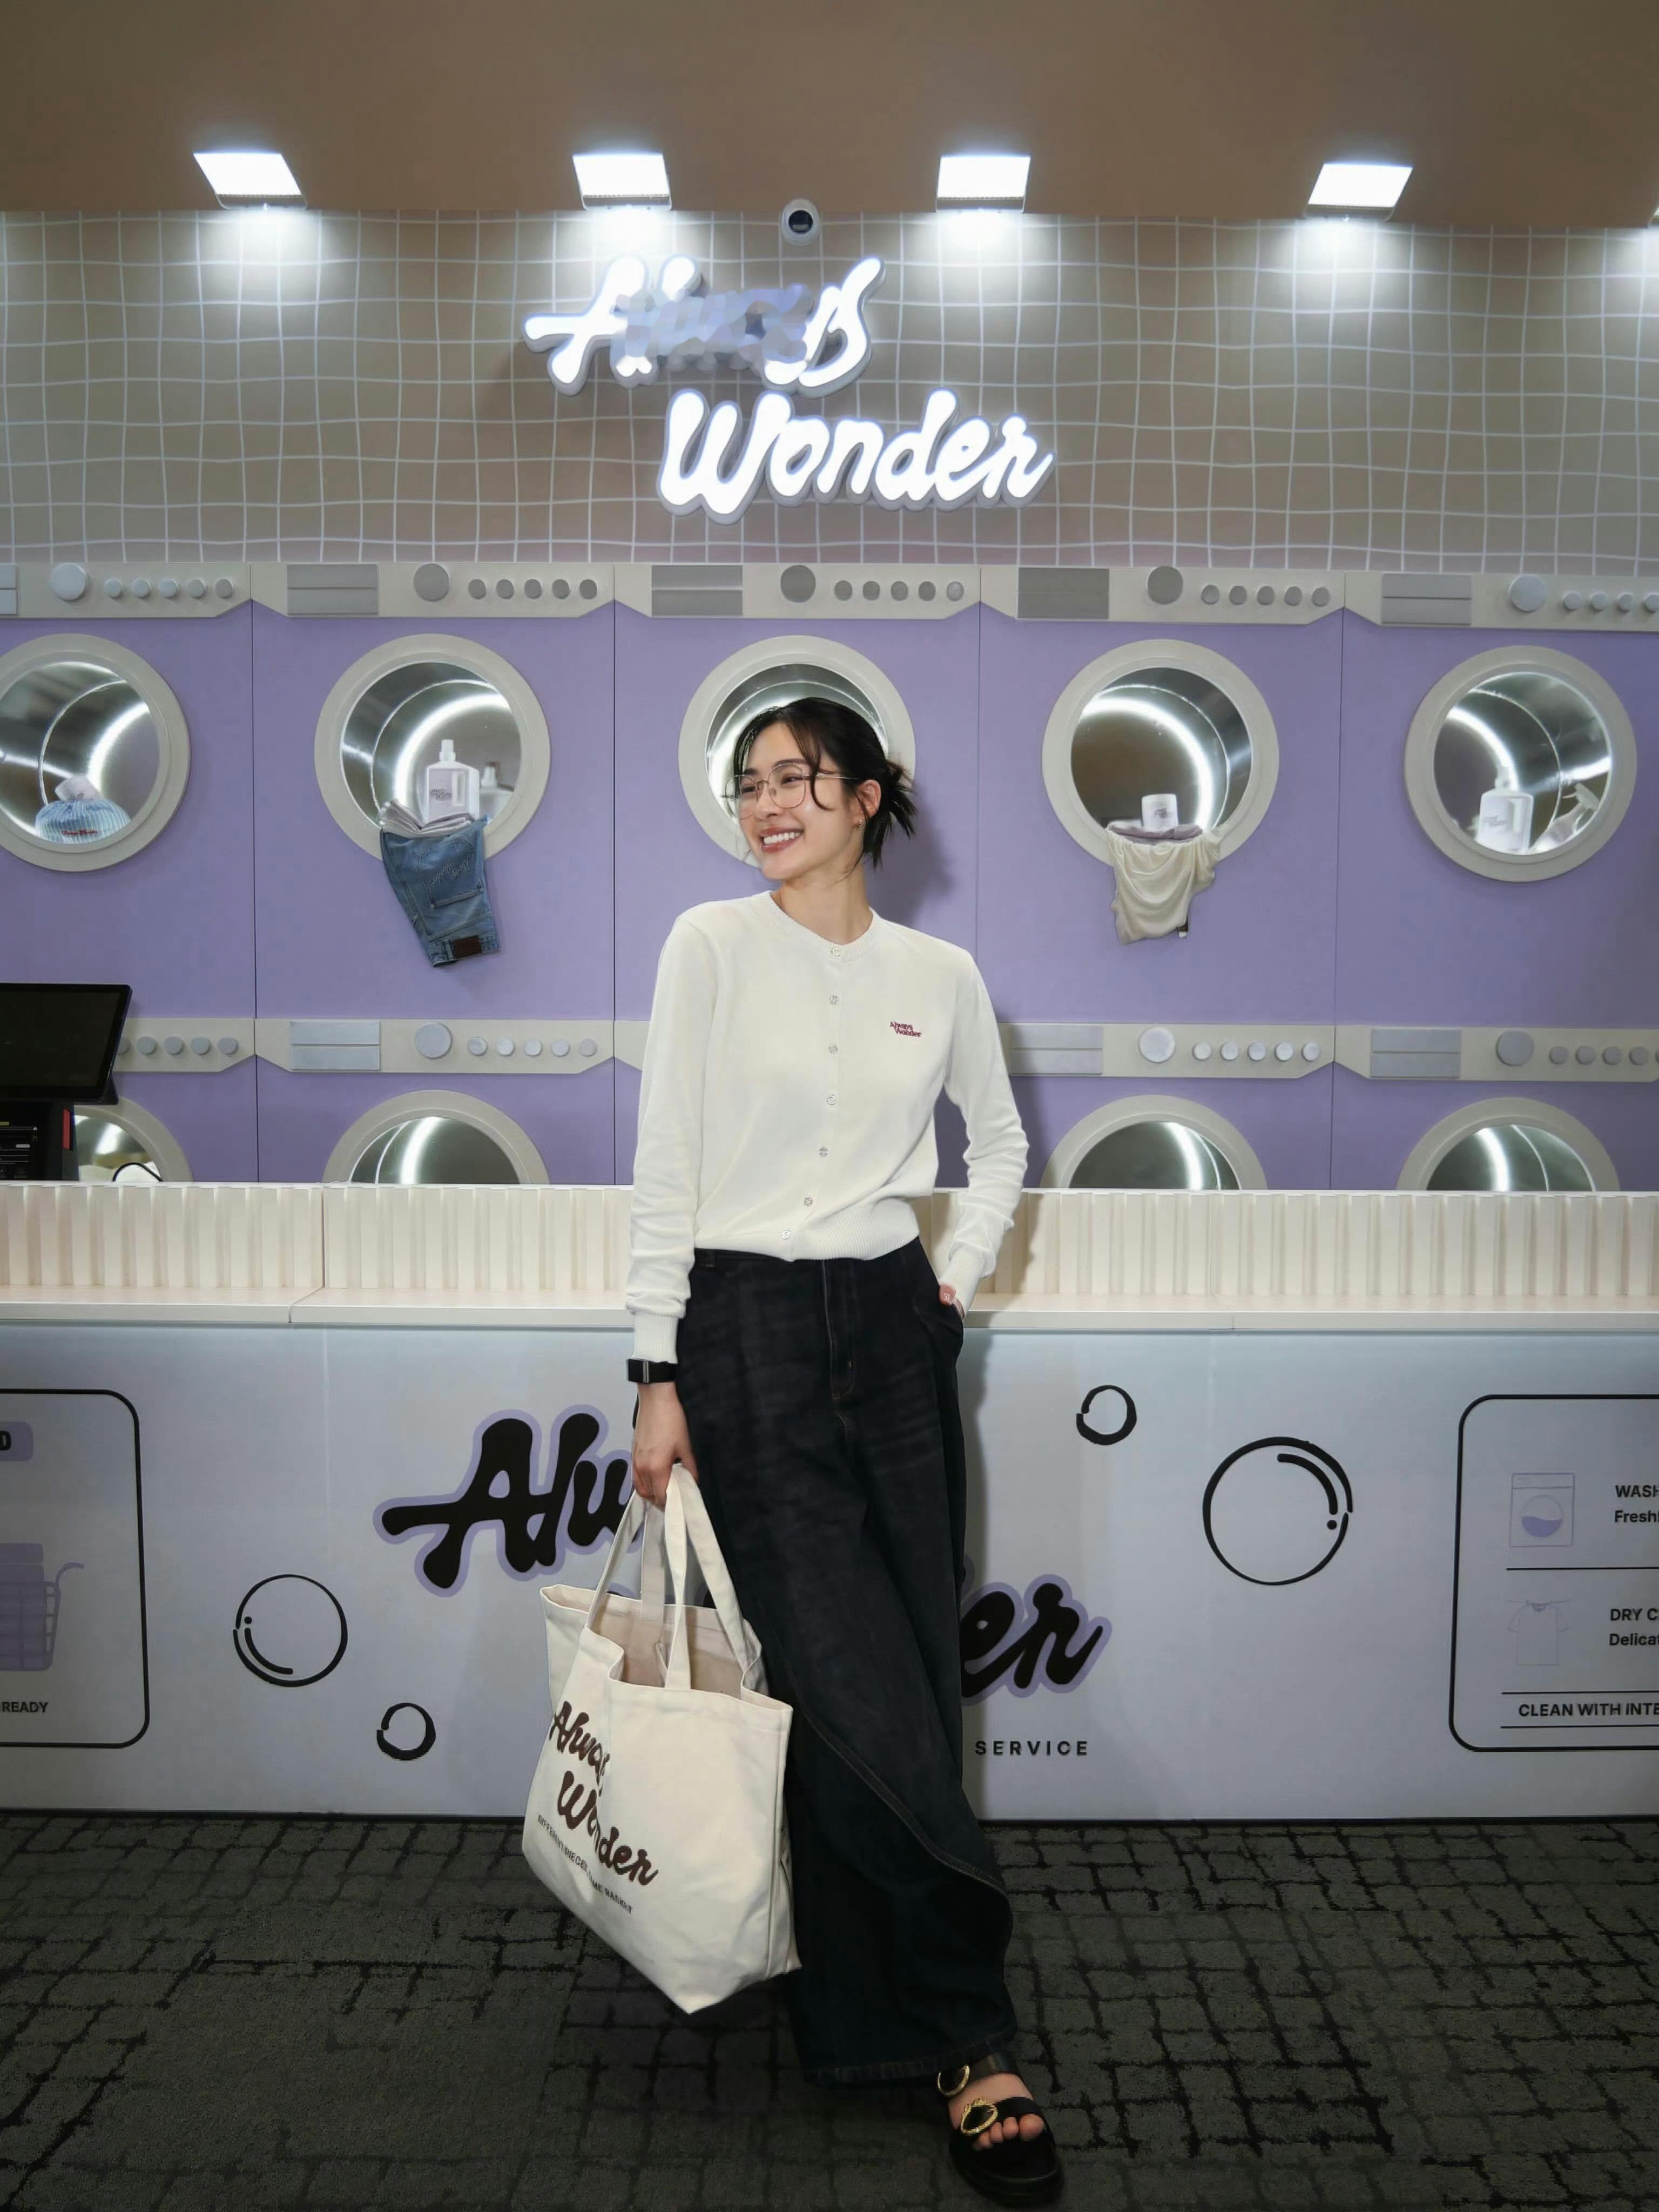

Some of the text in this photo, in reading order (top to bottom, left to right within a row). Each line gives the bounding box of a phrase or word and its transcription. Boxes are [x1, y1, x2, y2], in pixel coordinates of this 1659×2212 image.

[658, 387, 1054, 521] Wonder
[1610, 1608, 1643, 1621] DRY
[2, 1702, 48, 1713] READY
[1519, 1704, 1573, 1716] CLEAN
[1577, 1703, 1621, 1716] WITH
[975, 1741, 1088, 1756] SERVICE
